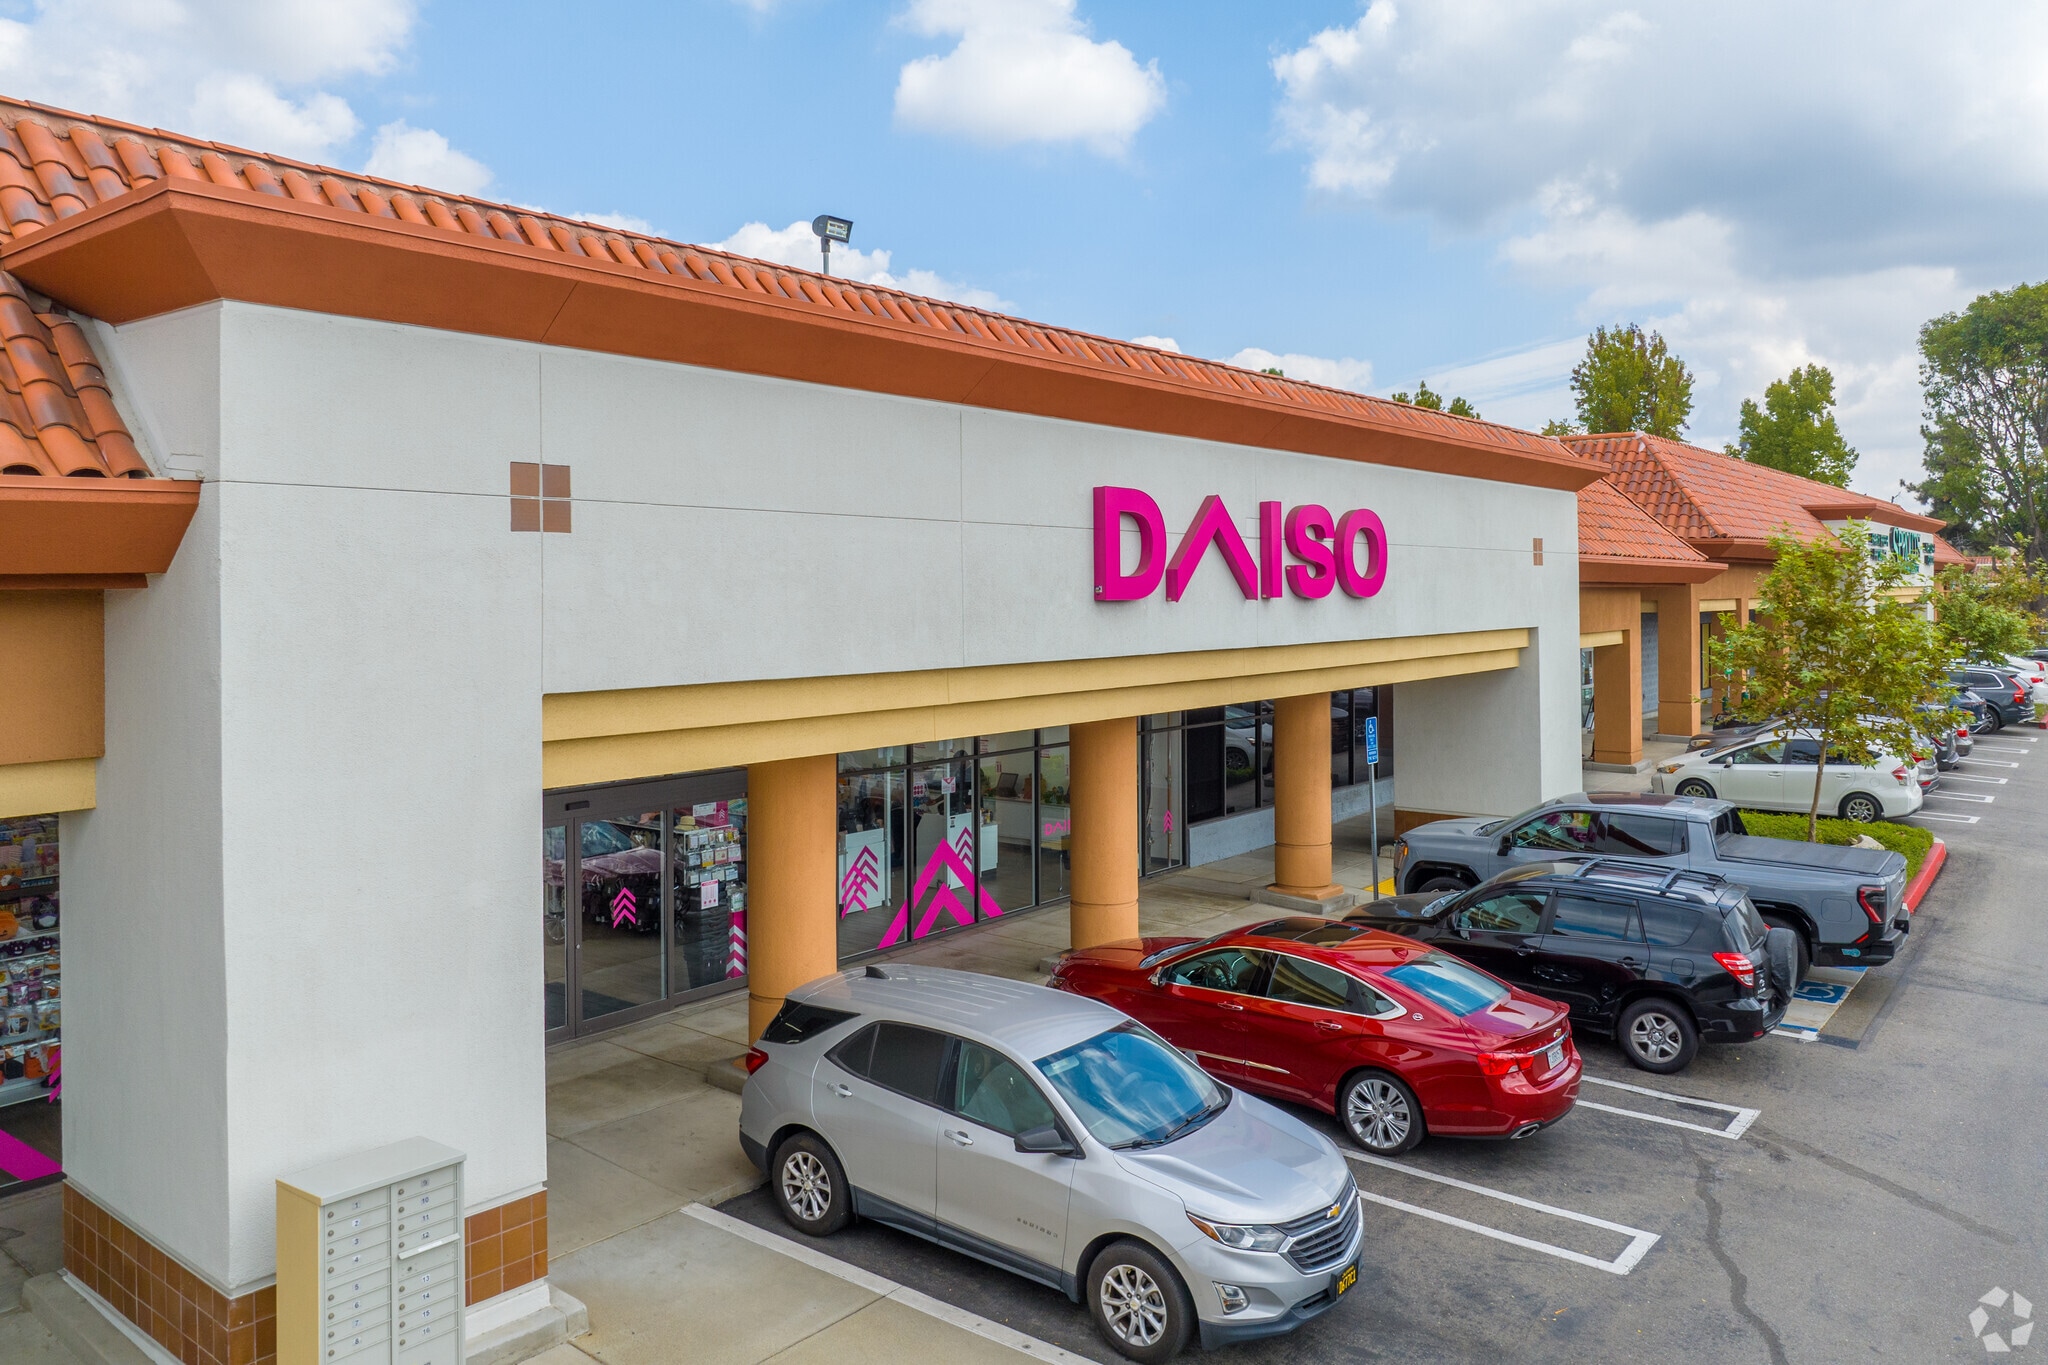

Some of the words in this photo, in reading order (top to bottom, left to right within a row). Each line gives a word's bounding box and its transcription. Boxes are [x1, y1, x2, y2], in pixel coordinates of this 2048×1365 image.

[1093, 486, 1388, 602] DAISO
[422, 1196, 430, 1204] 10
[422, 1213, 430, 1221] 11
[422, 1231, 430, 1239] 12
[422, 1275, 430, 1283] 13
[422, 1292, 430, 1300] 14
[422, 1327, 431, 1335] 16
